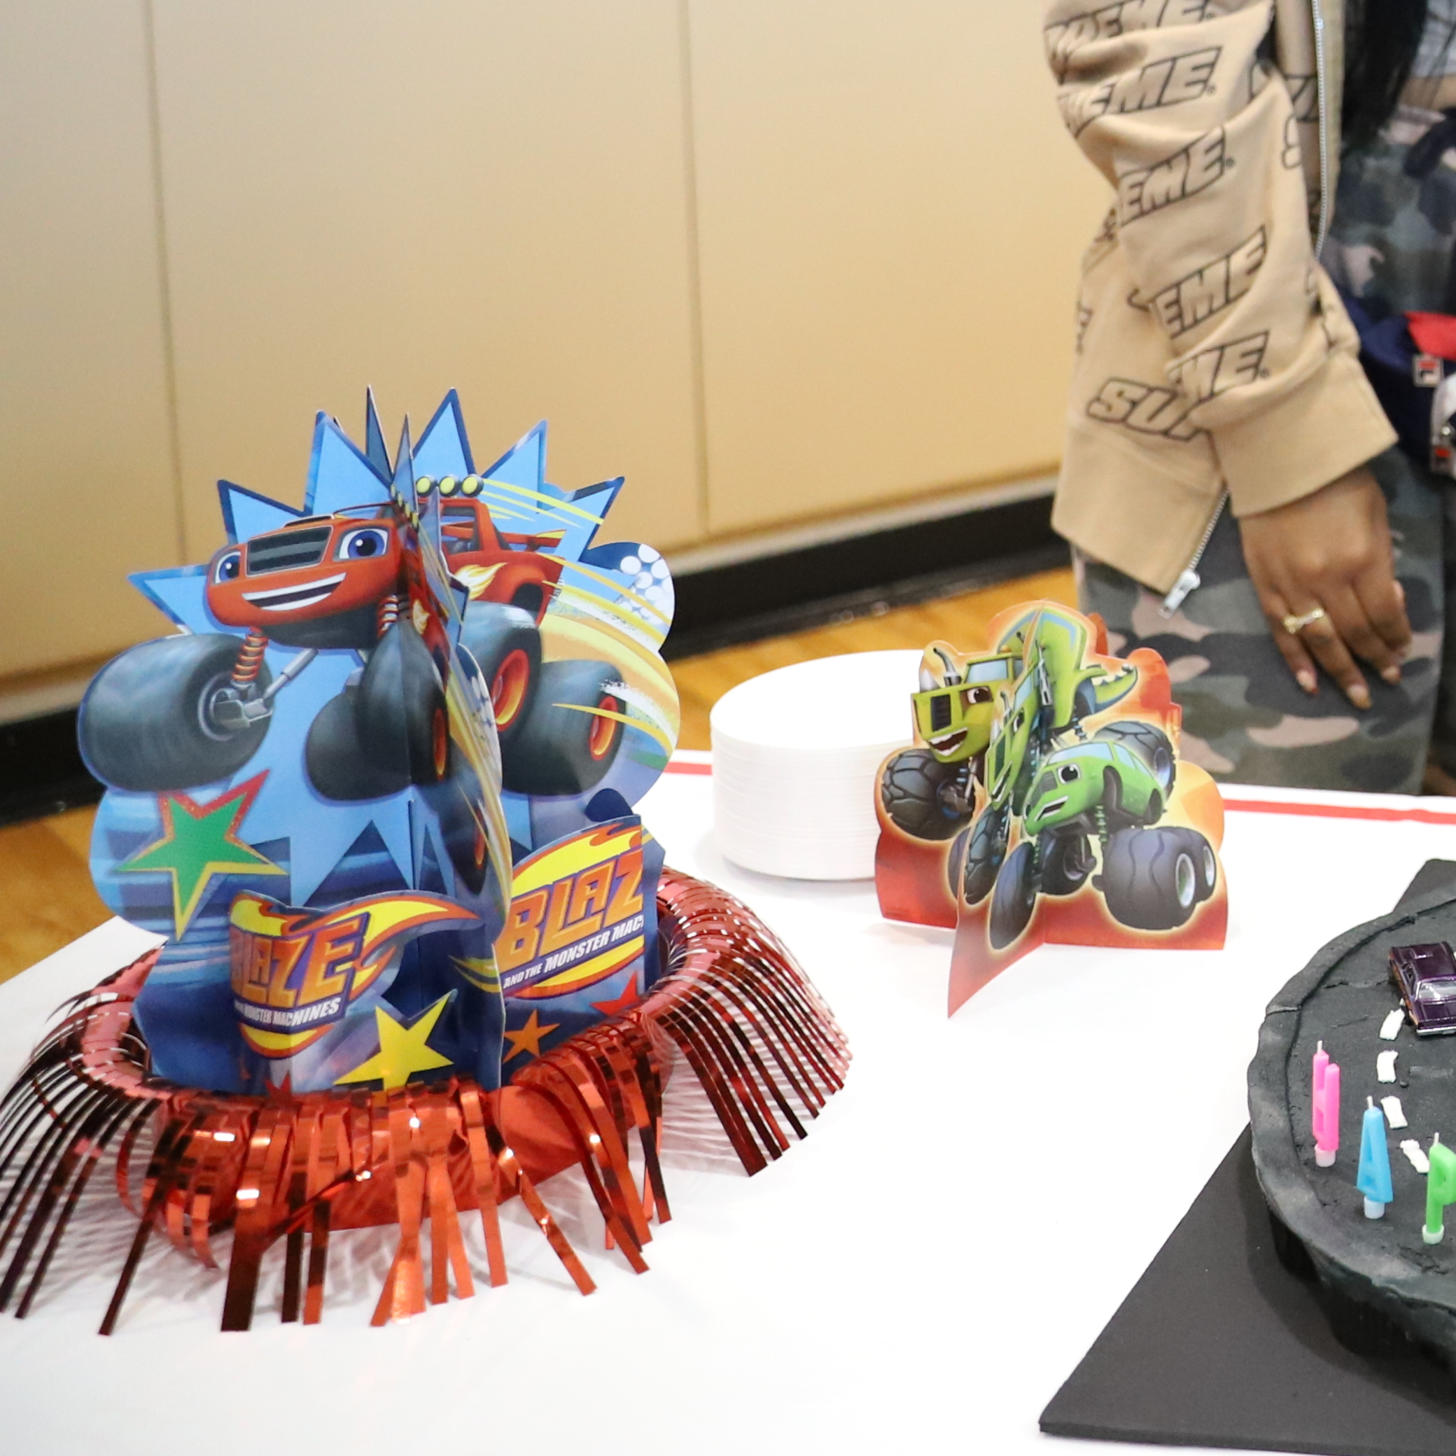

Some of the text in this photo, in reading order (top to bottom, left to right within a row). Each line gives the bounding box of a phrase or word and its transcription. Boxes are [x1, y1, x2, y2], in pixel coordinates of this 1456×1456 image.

[503, 974, 524, 989] AND
[525, 963, 544, 981] THE
[544, 931, 611, 973] MONSTER
